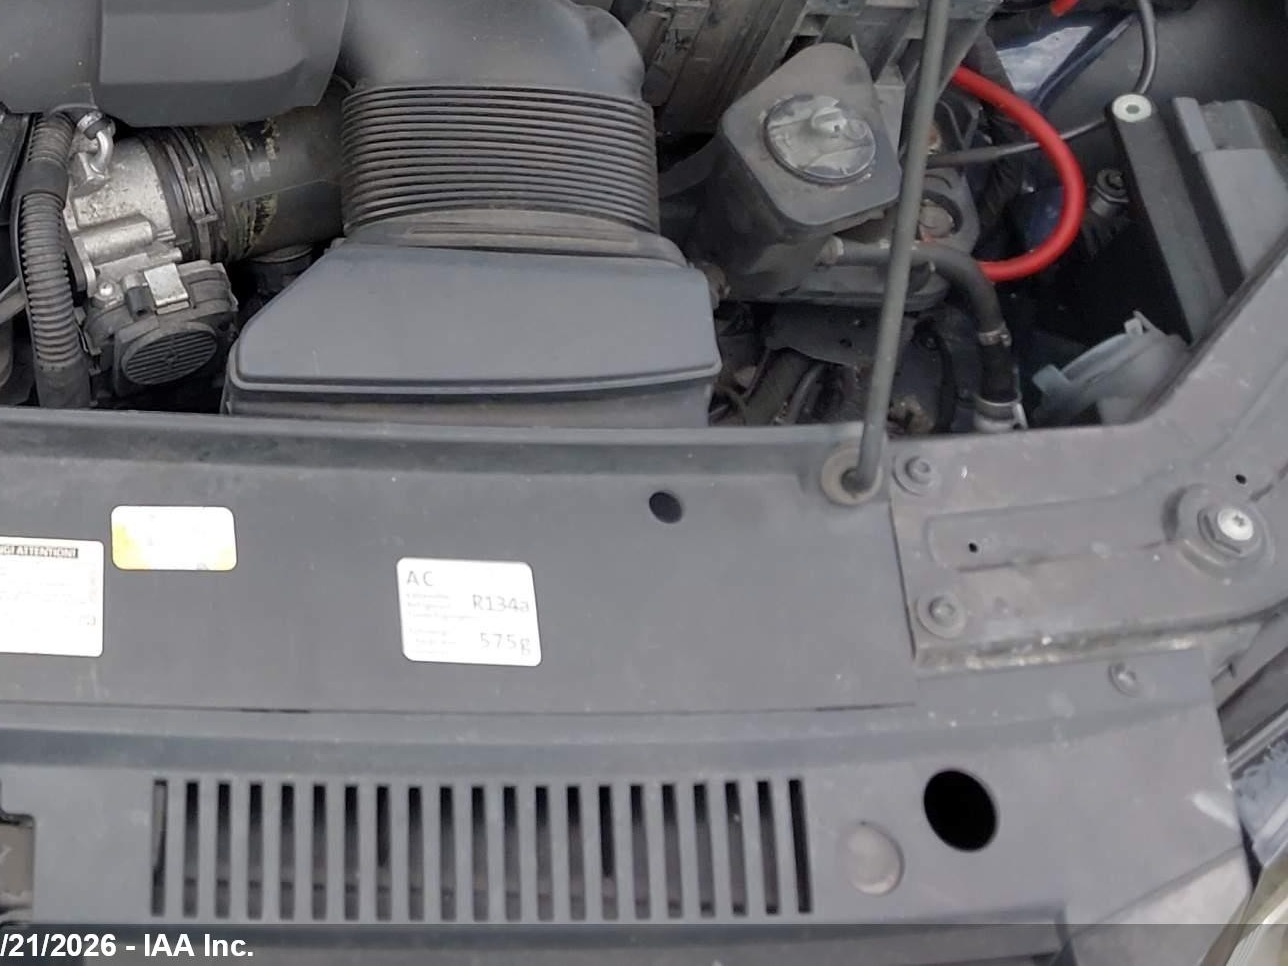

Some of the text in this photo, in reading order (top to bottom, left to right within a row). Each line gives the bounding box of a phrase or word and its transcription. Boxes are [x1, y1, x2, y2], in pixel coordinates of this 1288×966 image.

[15, 545, 75, 558] ATTENTION!
[406, 570, 433, 586] AC
[472, 594, 530, 613] R134a
